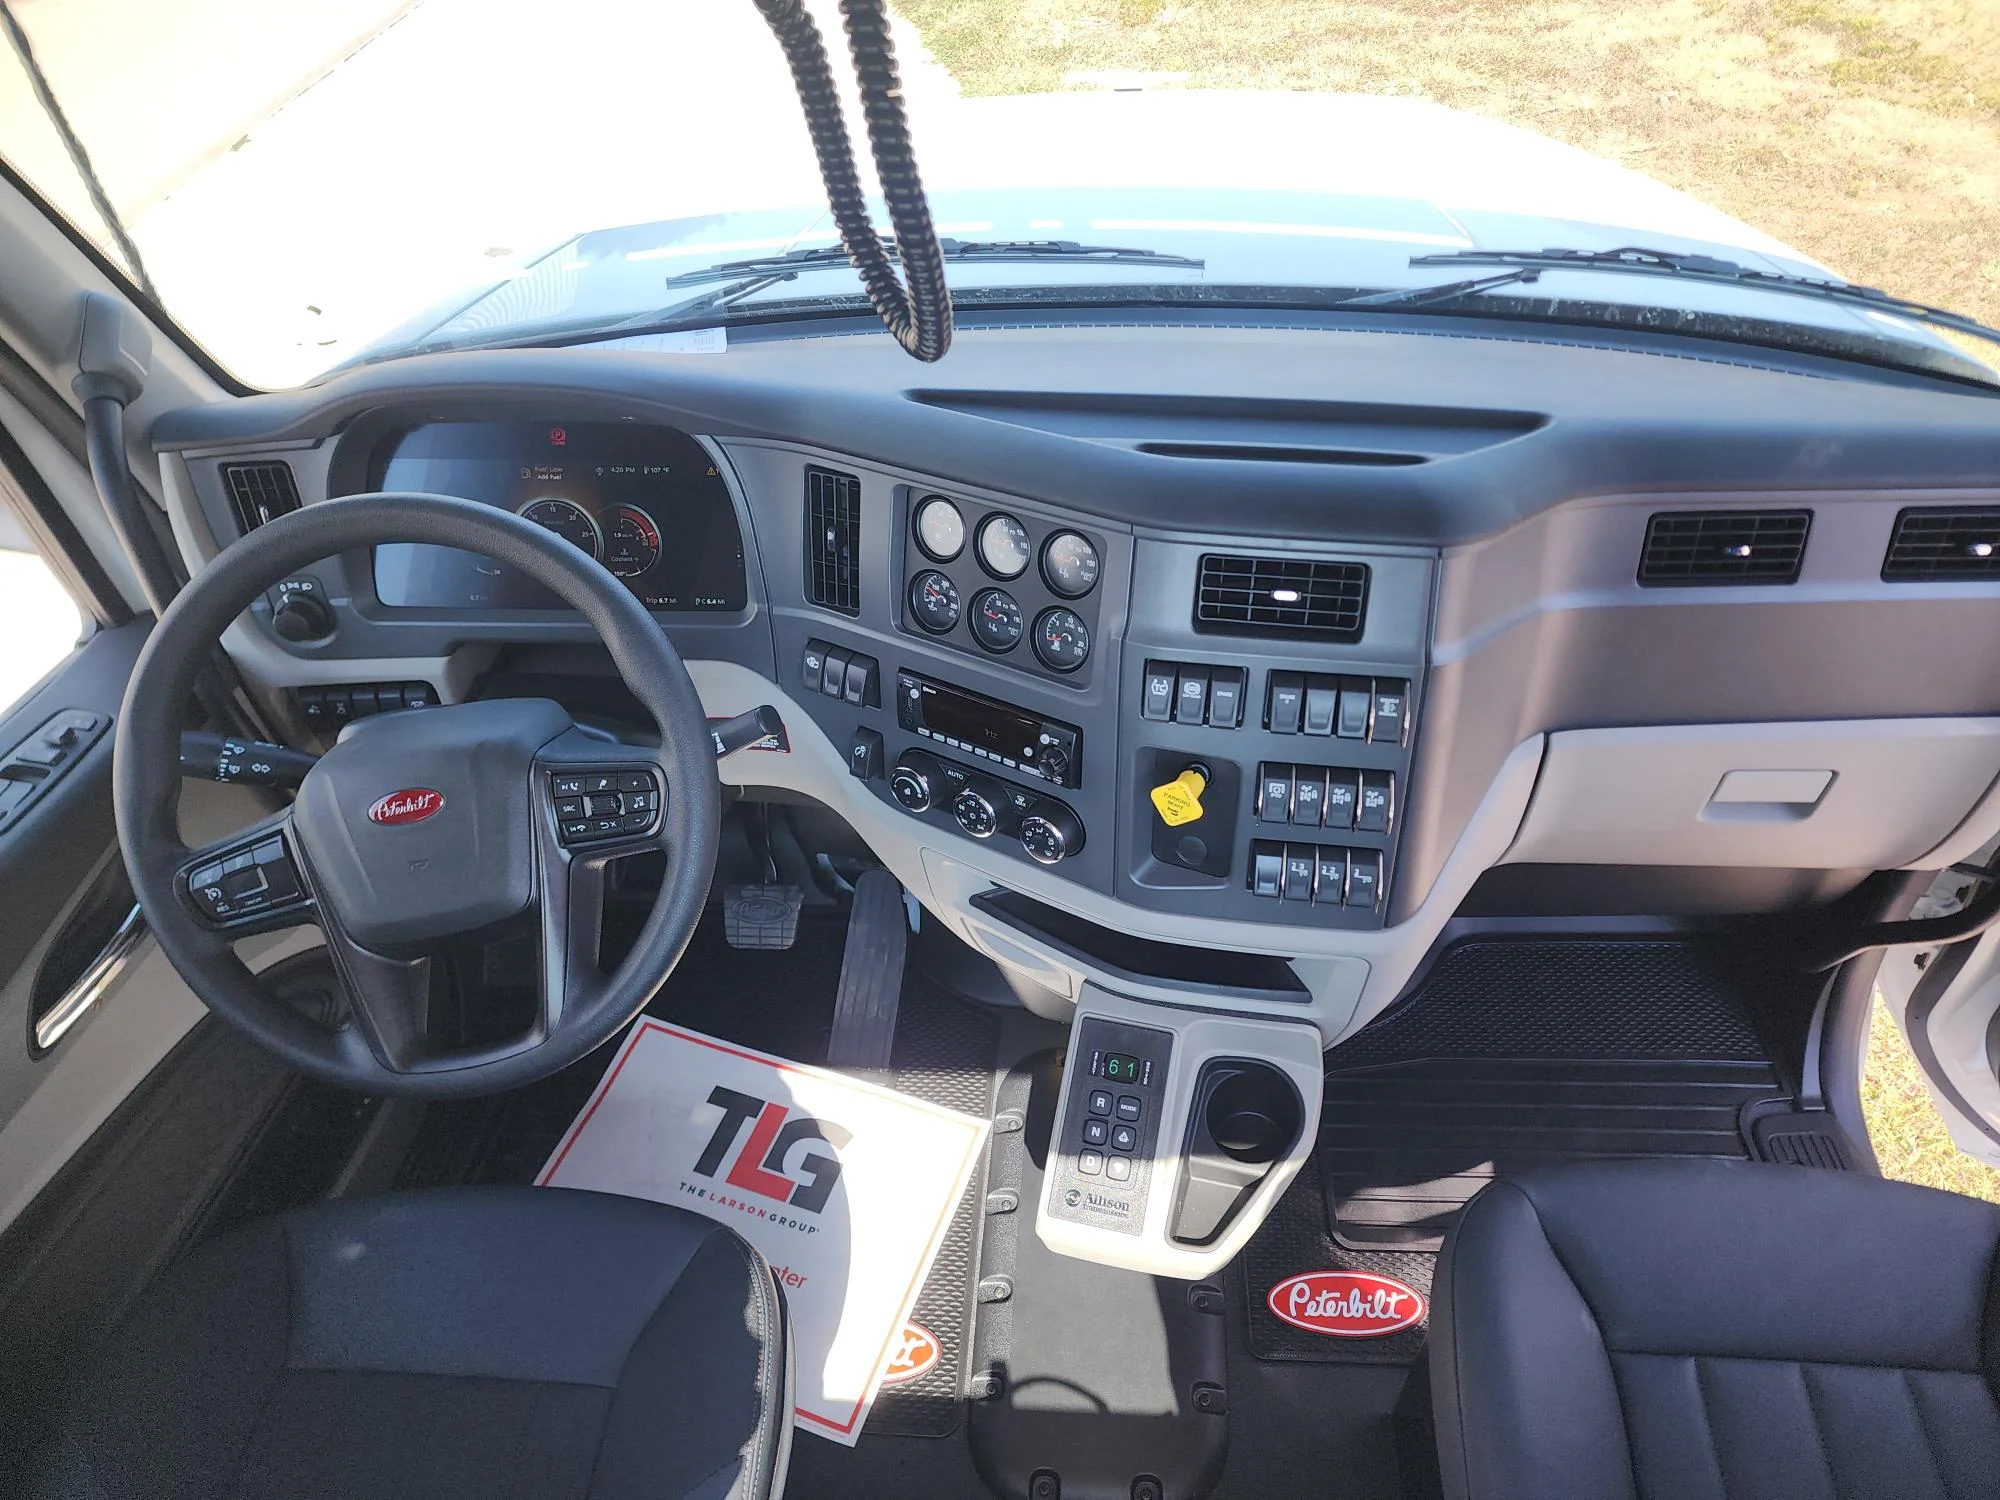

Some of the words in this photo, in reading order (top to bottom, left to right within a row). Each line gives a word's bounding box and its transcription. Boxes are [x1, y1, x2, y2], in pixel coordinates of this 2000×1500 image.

[645, 597, 658, 605] Trip
[947, 769, 964, 781] AUTO
[1163, 792, 1191, 808] PARKING
[562, 804, 577, 813] SRC
[1108, 1059, 1120, 1075] 6
[1127, 1062, 1135, 1078] 1
[1096, 1097, 1106, 1108] R
[1120, 1103, 1138, 1112] MODE
[1091, 1126, 1101, 1137] N
[693, 1085, 854, 1215] TLG
[1085, 1155, 1096, 1167] D
[679, 1182, 706, 1197] THE
[709, 1193, 767, 1218] LARSON
[769, 1214, 817, 1234] GROUP
[1083, 1192, 1130, 1212] Allison
[1289, 1282, 1408, 1320] Peterbilt
